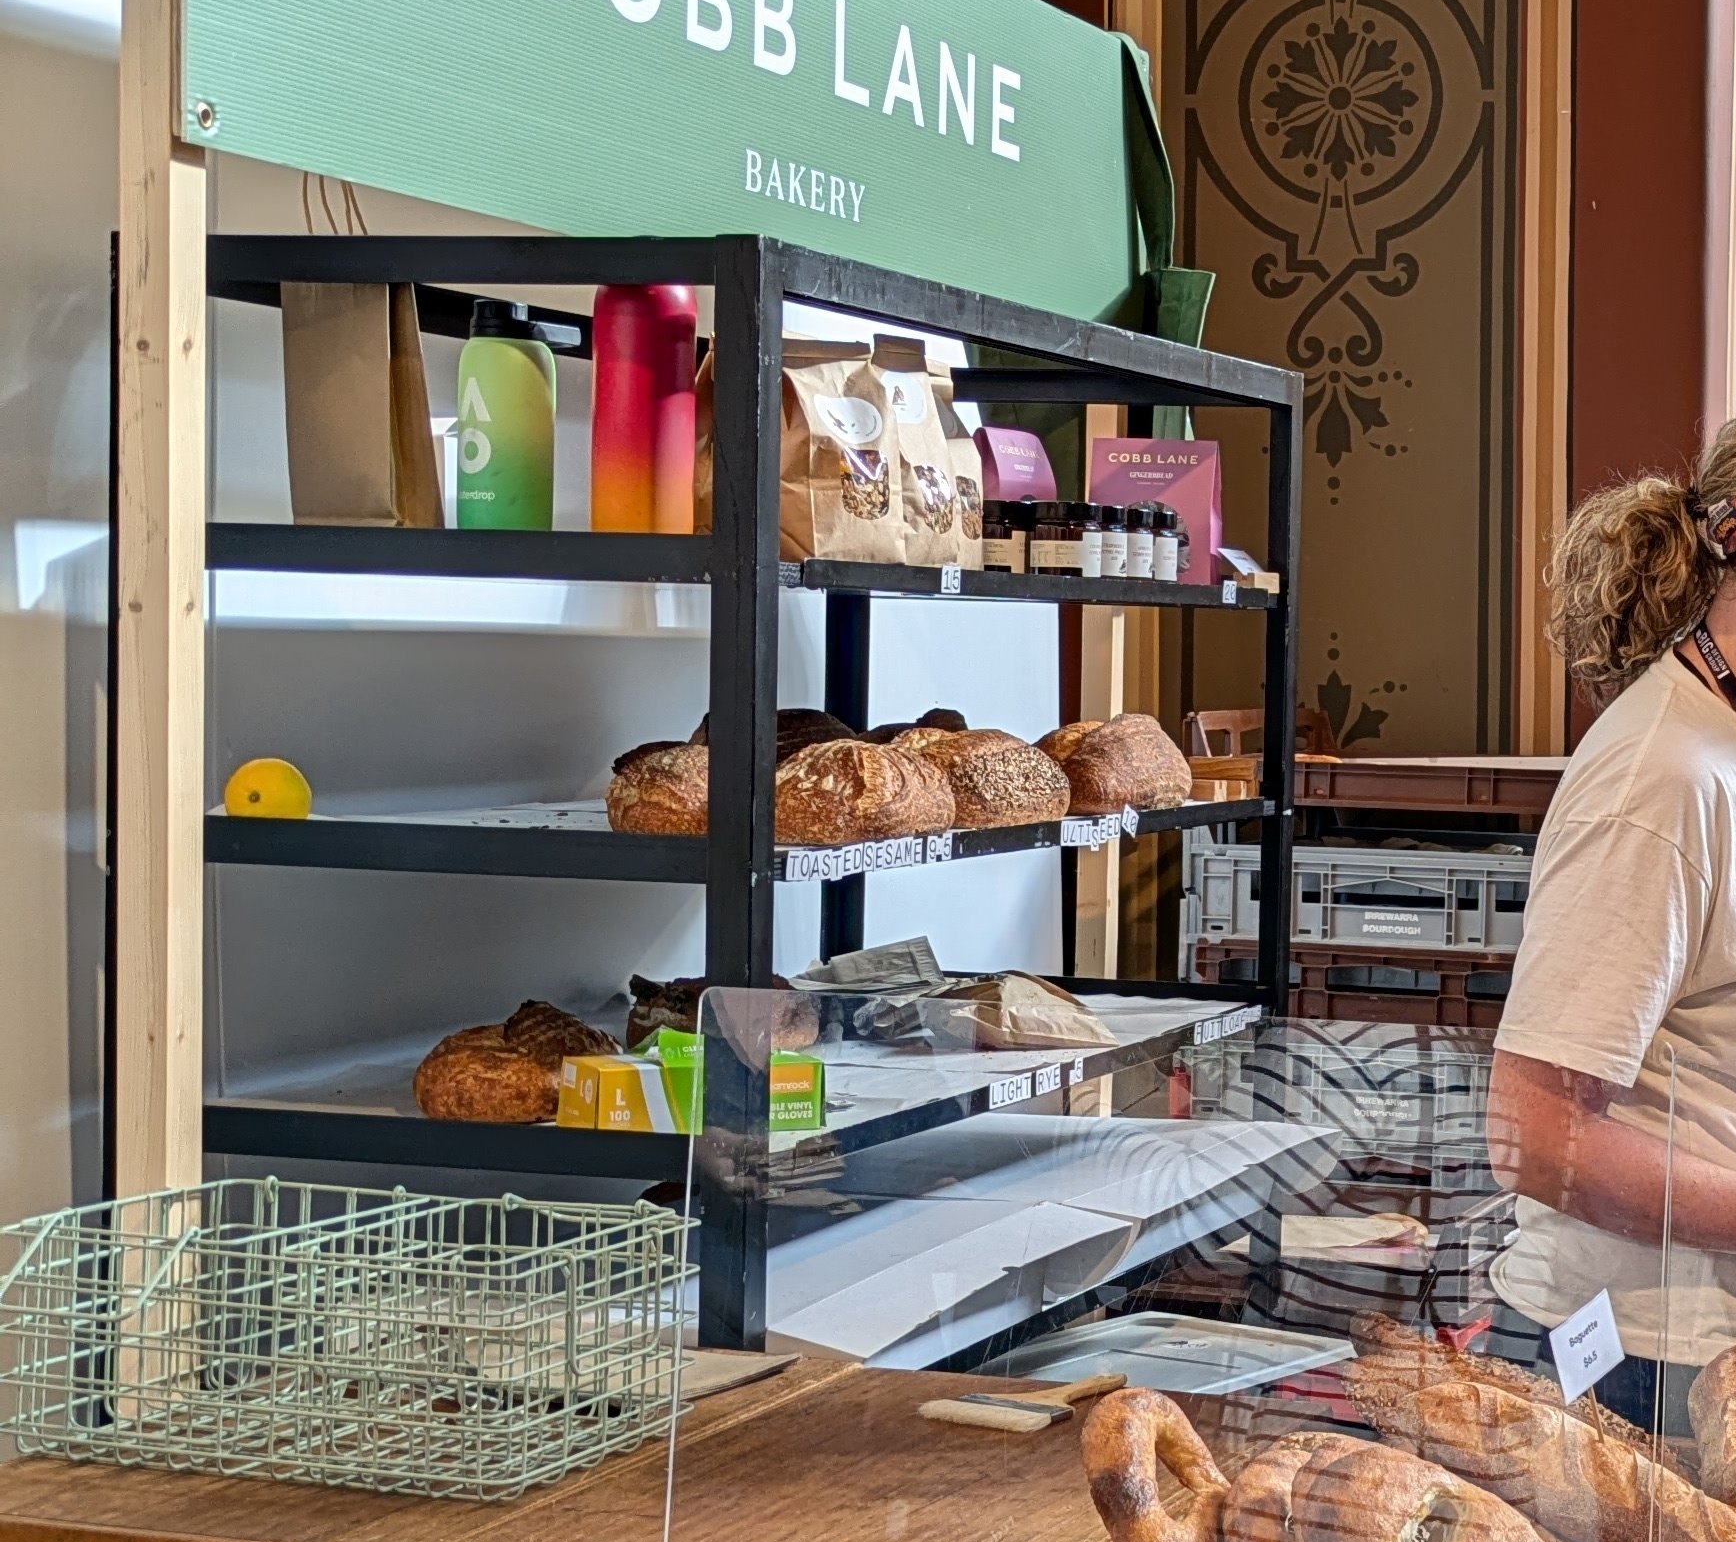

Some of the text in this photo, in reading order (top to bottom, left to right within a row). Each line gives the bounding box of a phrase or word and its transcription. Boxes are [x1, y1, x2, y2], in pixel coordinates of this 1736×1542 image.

[744, 148, 867, 224] BAKERY
[1108, 452, 1199, 465] COBB LANE
[1129, 471, 1174, 479] GINGERBREAD
[943, 569, 960, 591] 15
[1697, 631, 1714, 654] BIG
[789, 837, 951, 878] TOASTED SESAME 9.5
[1362, 924, 1421, 935] SOURDOUGH
[991, 1076, 1031, 1106] LIGHT
[1037, 1066, 1060, 1093] RYE
[615, 1088, 626, 1107] L
[787, 1101, 814, 1111] VINYL
[609, 1109, 631, 1122] 100
[777, 1110, 813, 1120] GLOVES
[1568, 1319, 1599, 1348] Baguette
[1583, 1350, 1598, 1368] $6.5
